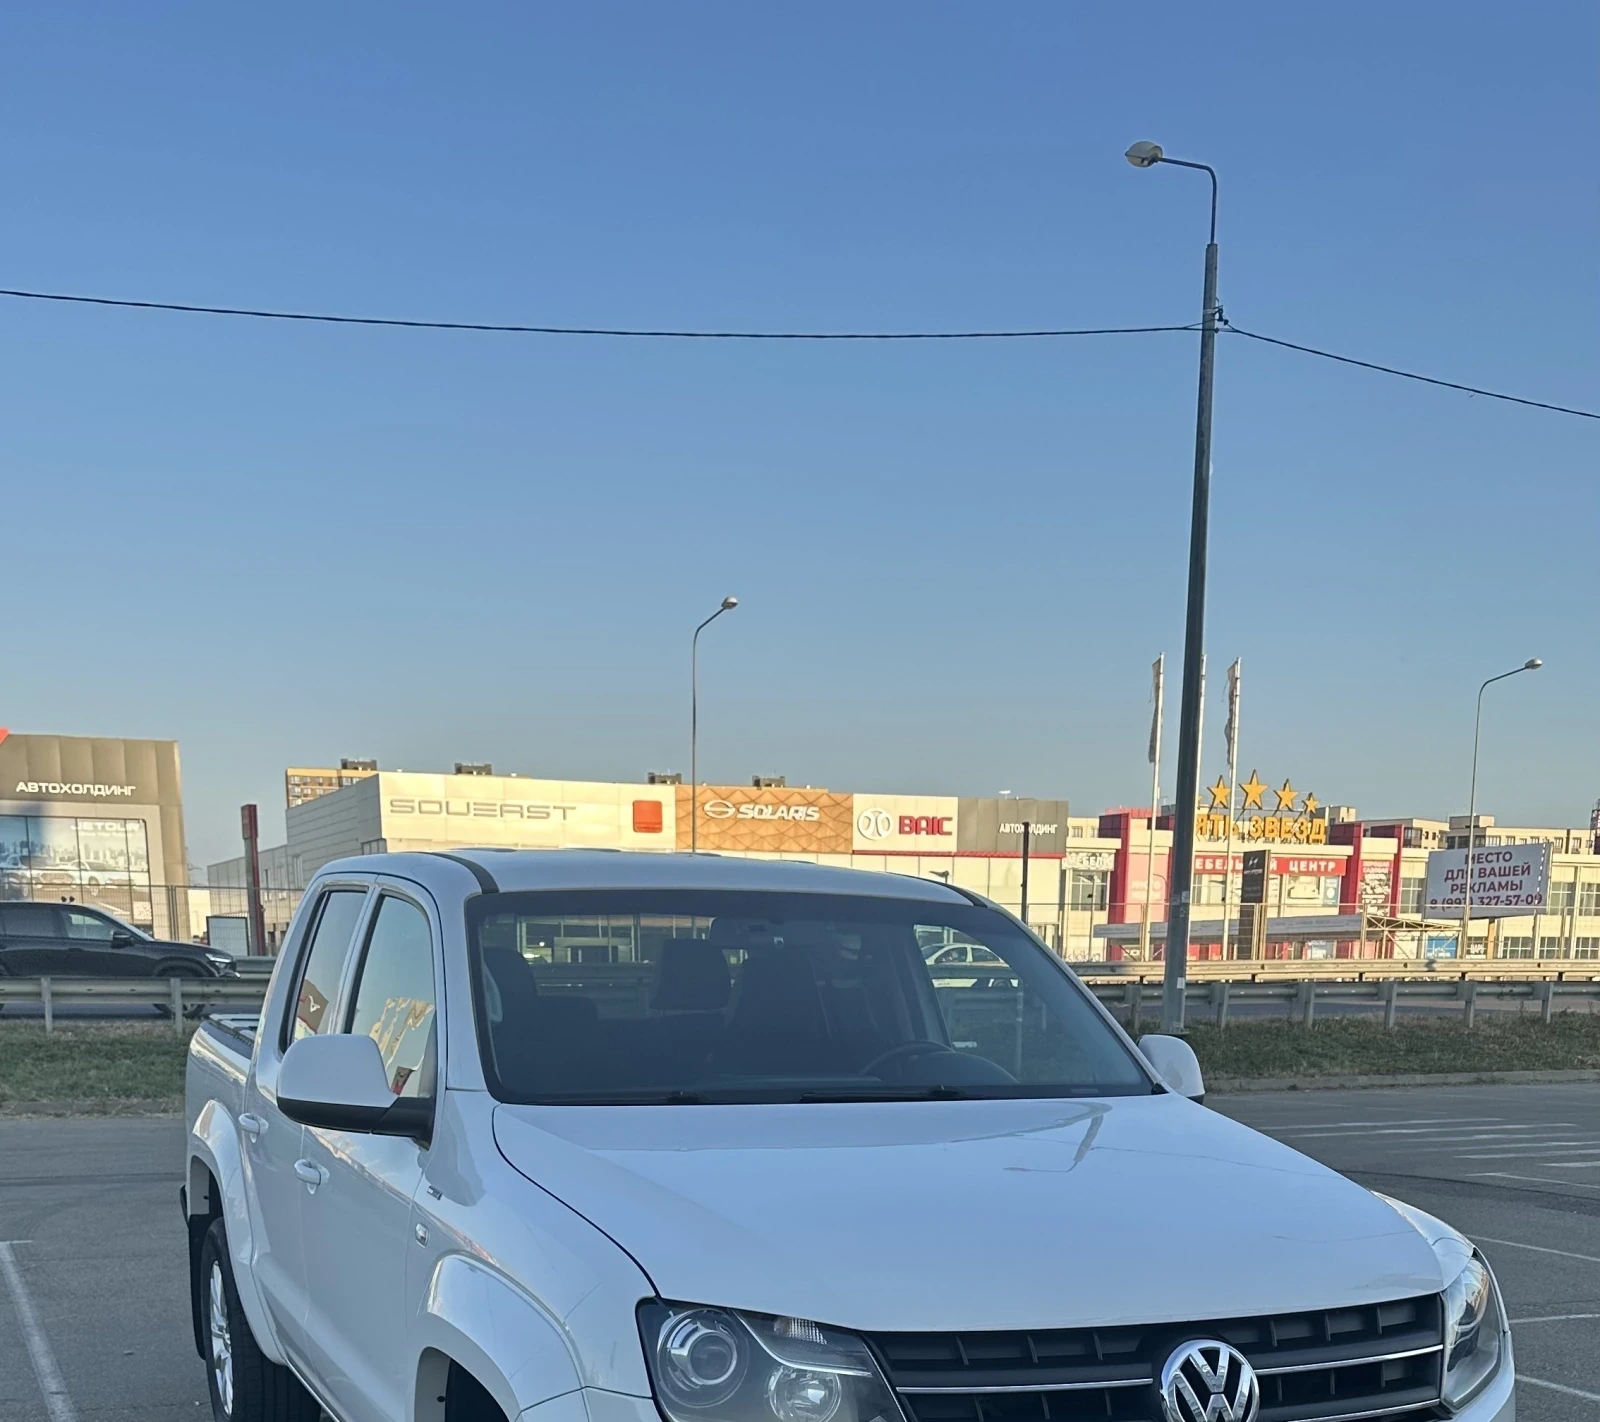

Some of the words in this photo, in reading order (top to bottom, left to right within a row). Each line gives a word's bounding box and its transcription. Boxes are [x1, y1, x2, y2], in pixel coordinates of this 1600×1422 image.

[15, 781, 136, 797] АВТОХОЛДИНГ
[390, 799, 577, 820] SOUEAST
[736, 804, 820, 821] SOLARIS
[898, 815, 953, 836] BAIC
[999, 823, 1058, 835] АВТОХЛДИНГ
[1195, 813, 1239, 835] ЯТЬ
[1249, 815, 1327, 844] ЗВЕЗД
[1464, 851, 1513, 865] МЕСТО
[1289, 861, 1336, 873] ЦЕНТР
[1478, 862, 1531, 879] ВАШЕЙ
[1450, 880, 1523, 894] РЕКЛАМЫ
